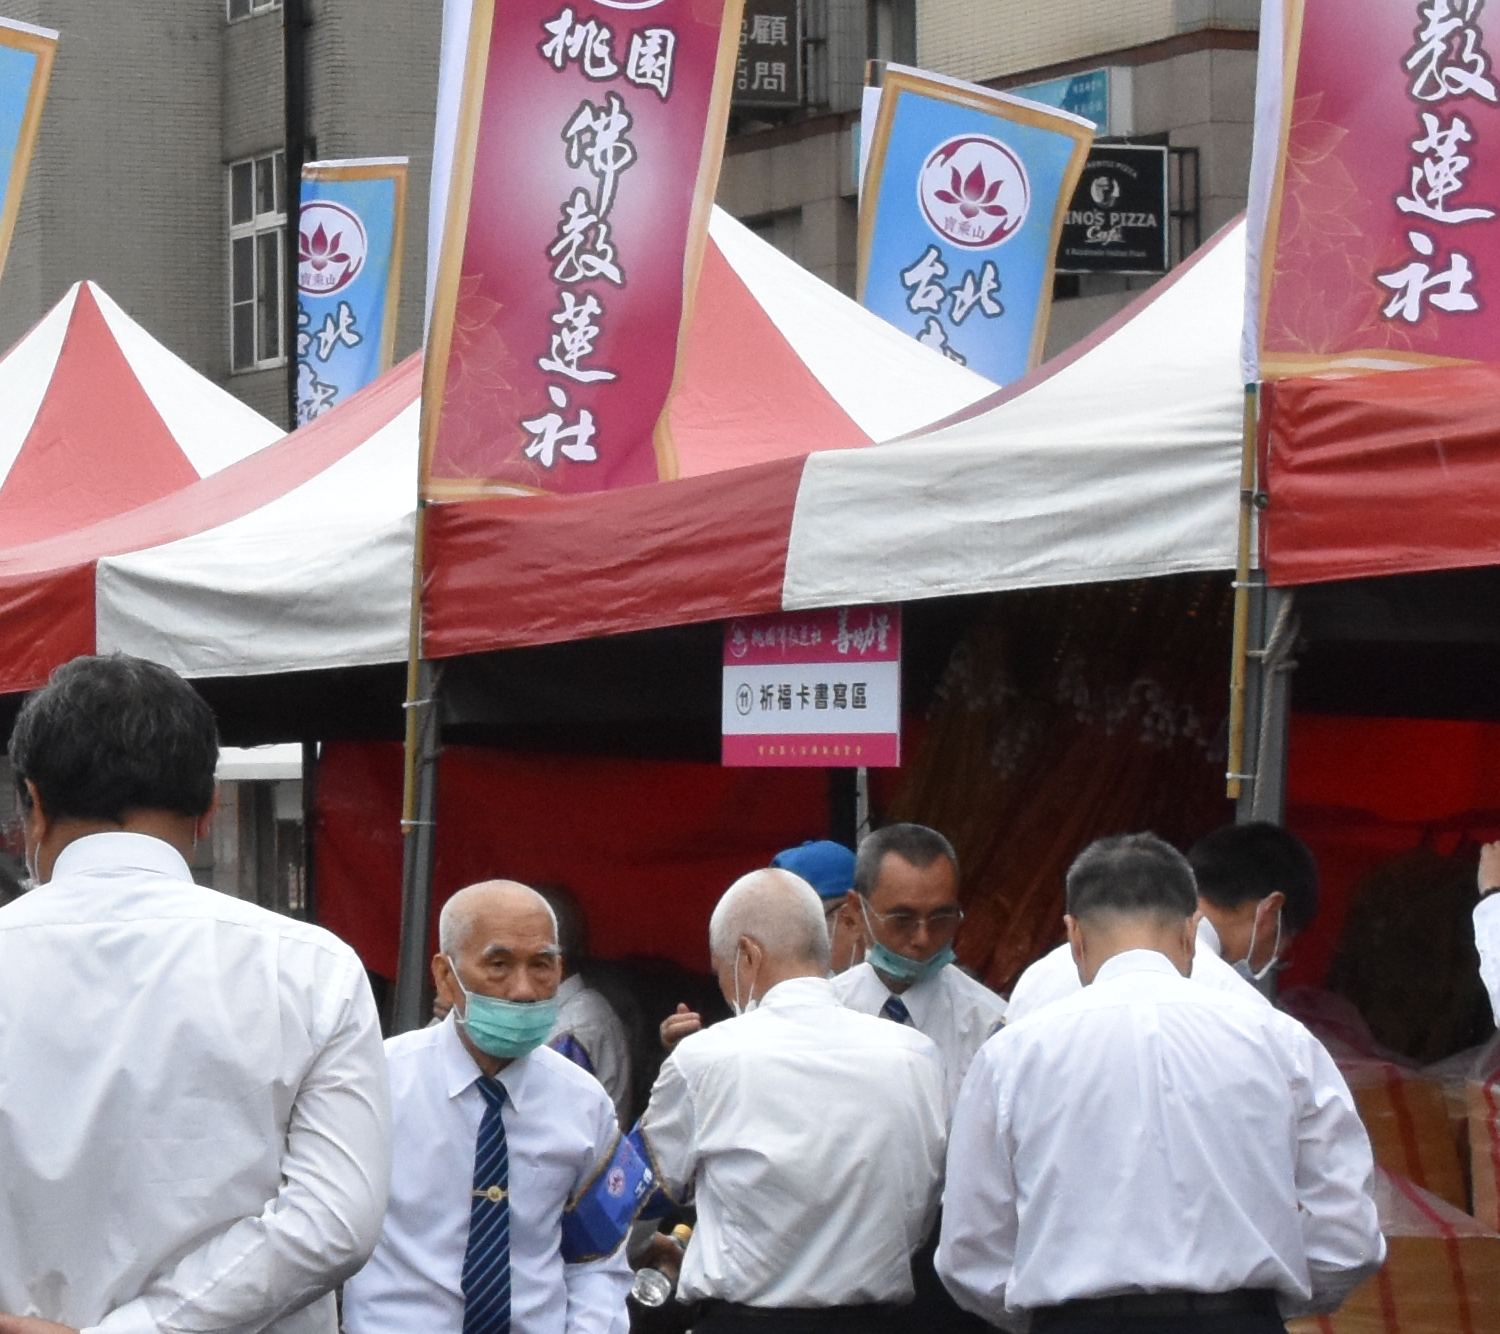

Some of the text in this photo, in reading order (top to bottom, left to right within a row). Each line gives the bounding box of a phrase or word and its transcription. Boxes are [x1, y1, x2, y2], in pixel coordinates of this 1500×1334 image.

[1110, 212, 1158, 228] PIZZA
[759, 682, 867, 710] 祈福卡書寫區
